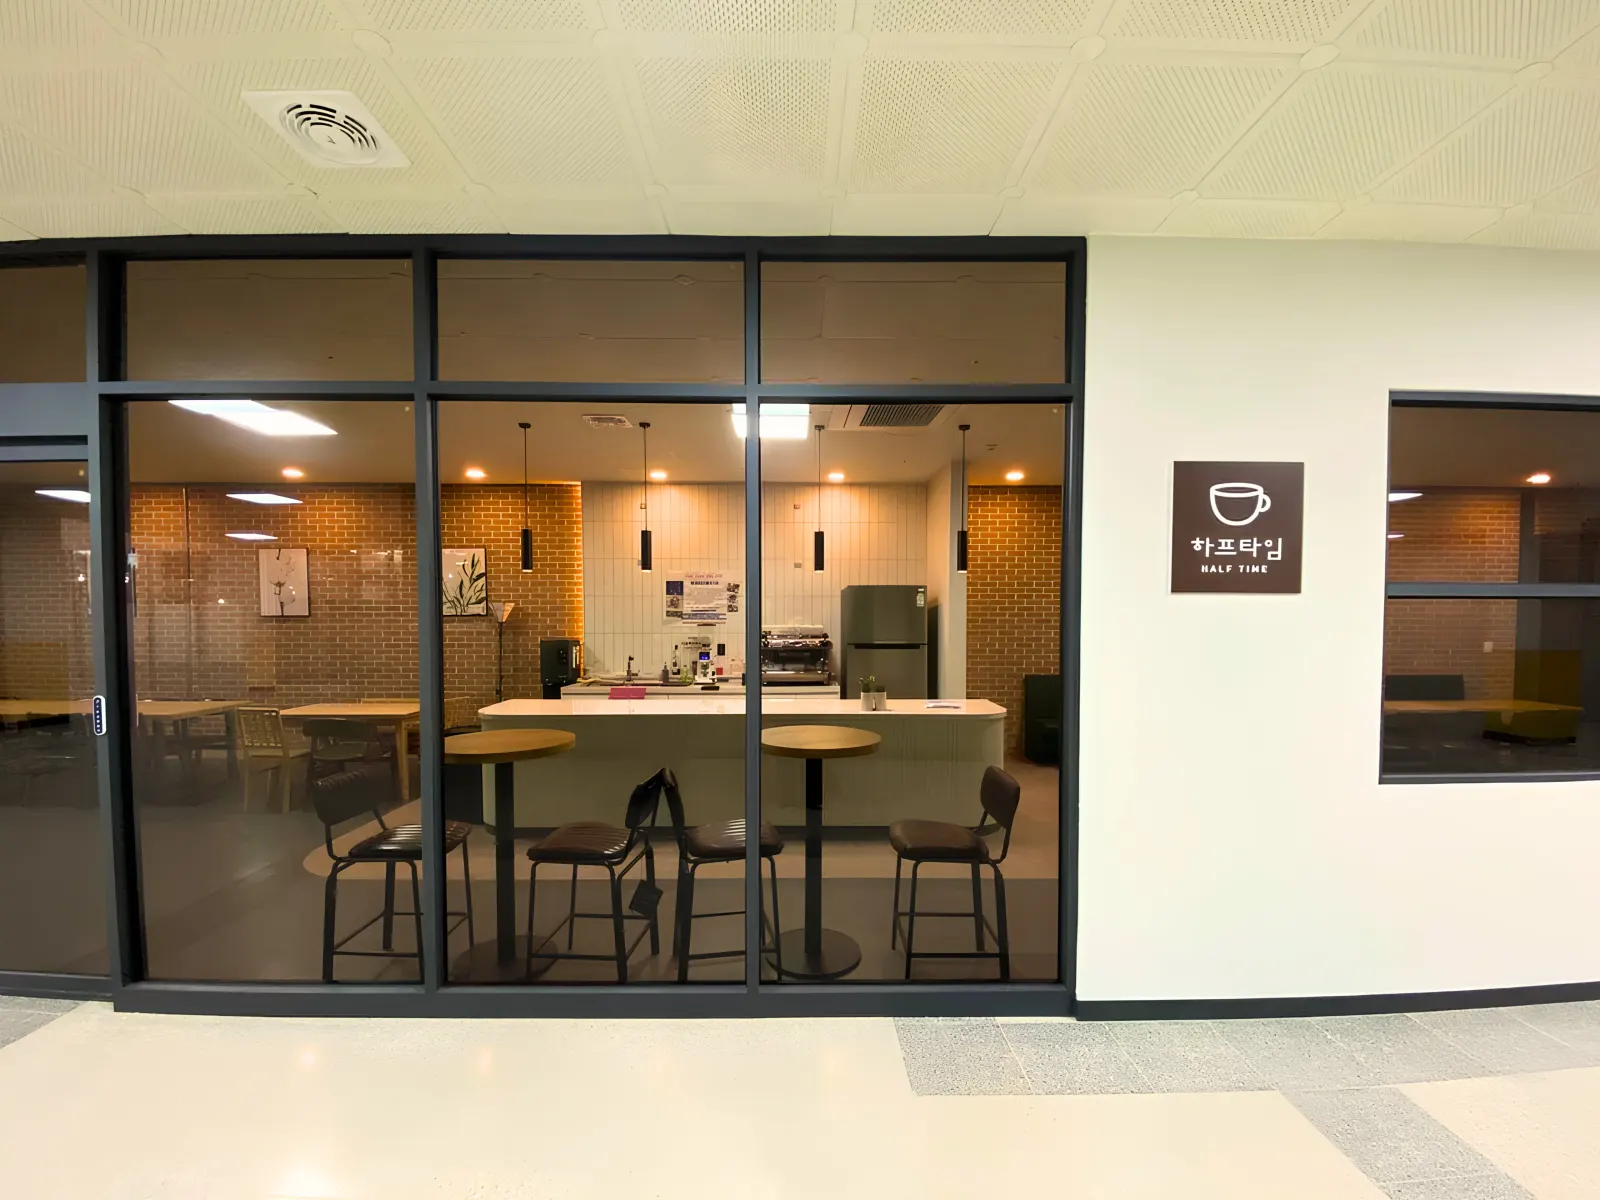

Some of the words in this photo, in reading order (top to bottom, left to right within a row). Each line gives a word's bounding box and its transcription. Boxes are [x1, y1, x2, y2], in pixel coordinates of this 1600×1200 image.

[1190, 537, 1283, 561] 하프타임
[1201, 565, 1233, 573] HALF
[1238, 565, 1268, 573] TIME
